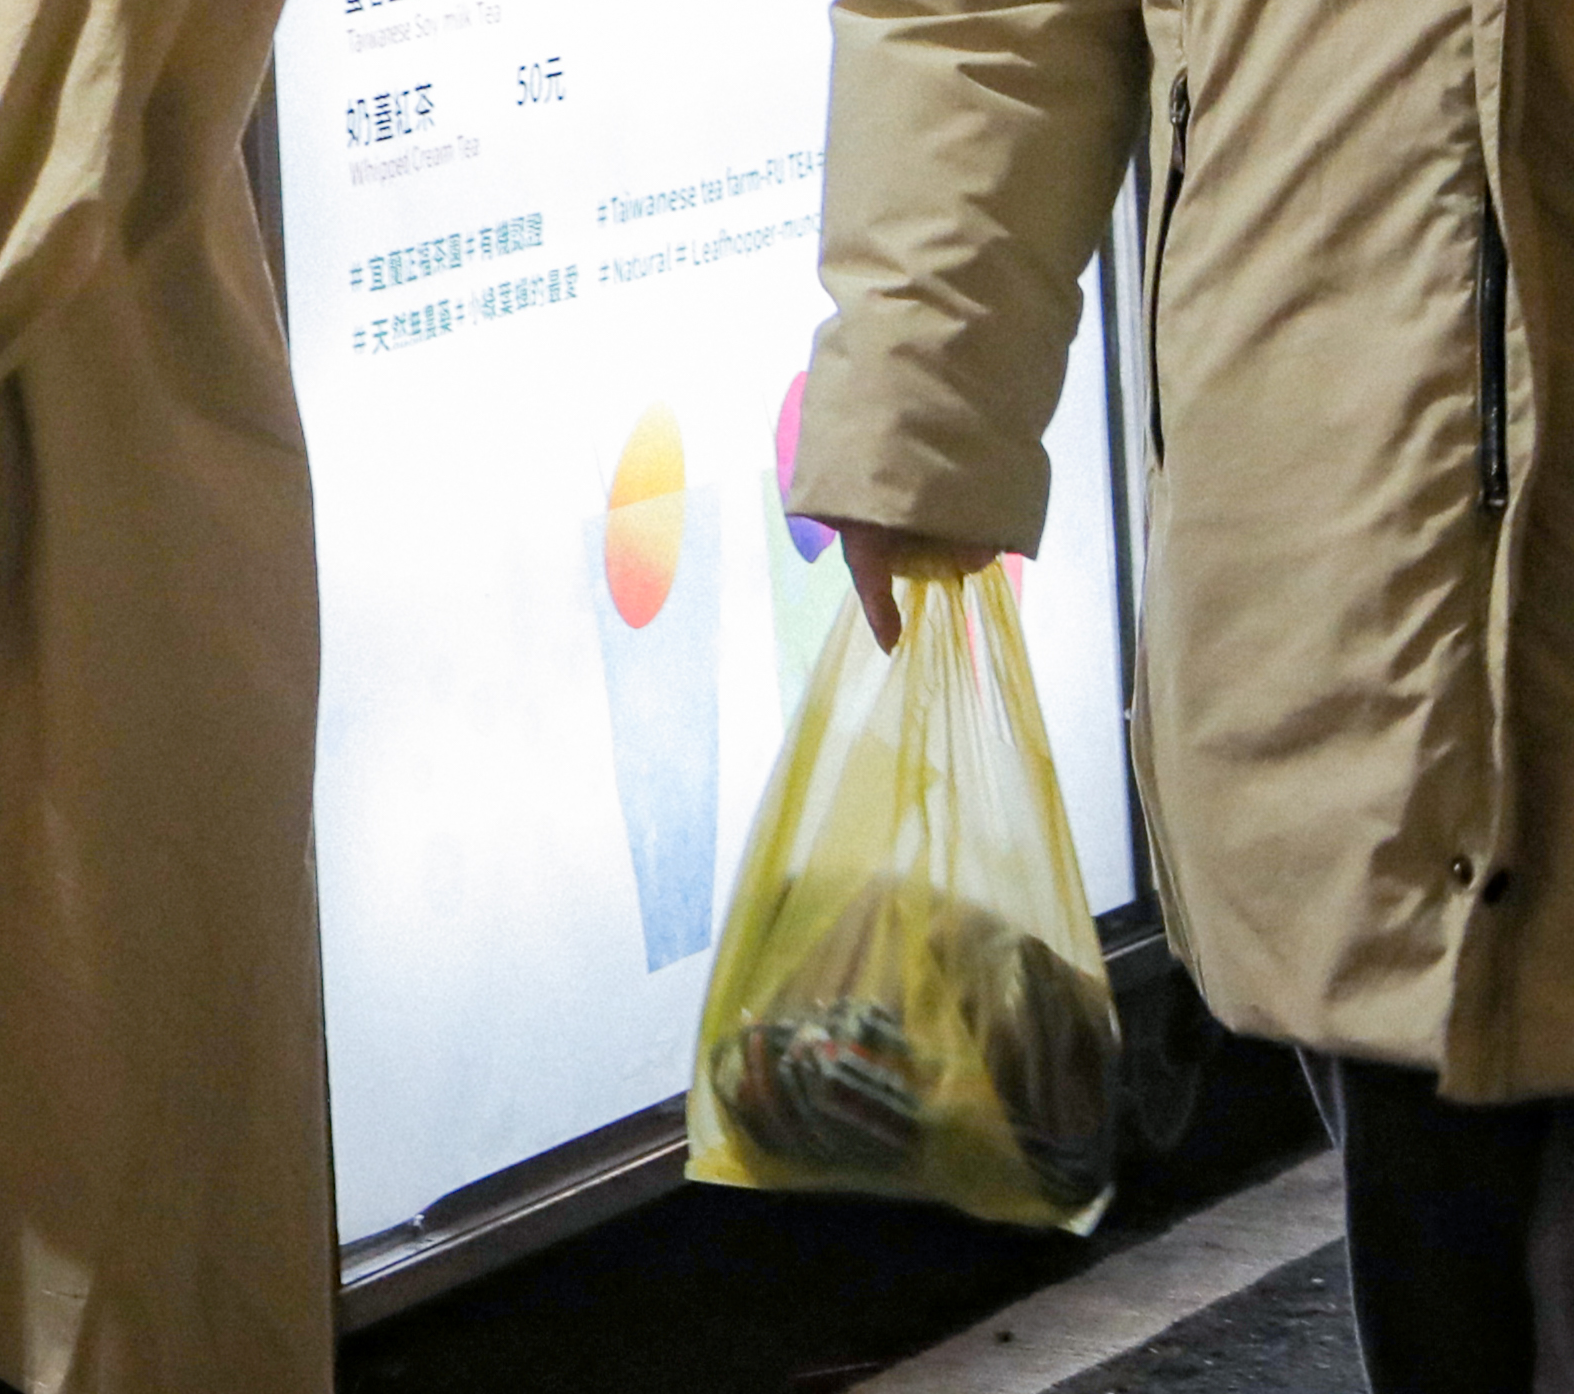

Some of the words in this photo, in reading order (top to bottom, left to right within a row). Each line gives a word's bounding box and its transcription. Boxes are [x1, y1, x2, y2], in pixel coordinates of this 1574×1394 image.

[346, 83, 435, 149] 奶蓋紅茶
[516, 57, 568, 106] 50元
[456, 134, 480, 161] Tea
[700, 176, 724, 204] tea
[787, 150, 816, 180] TEA
